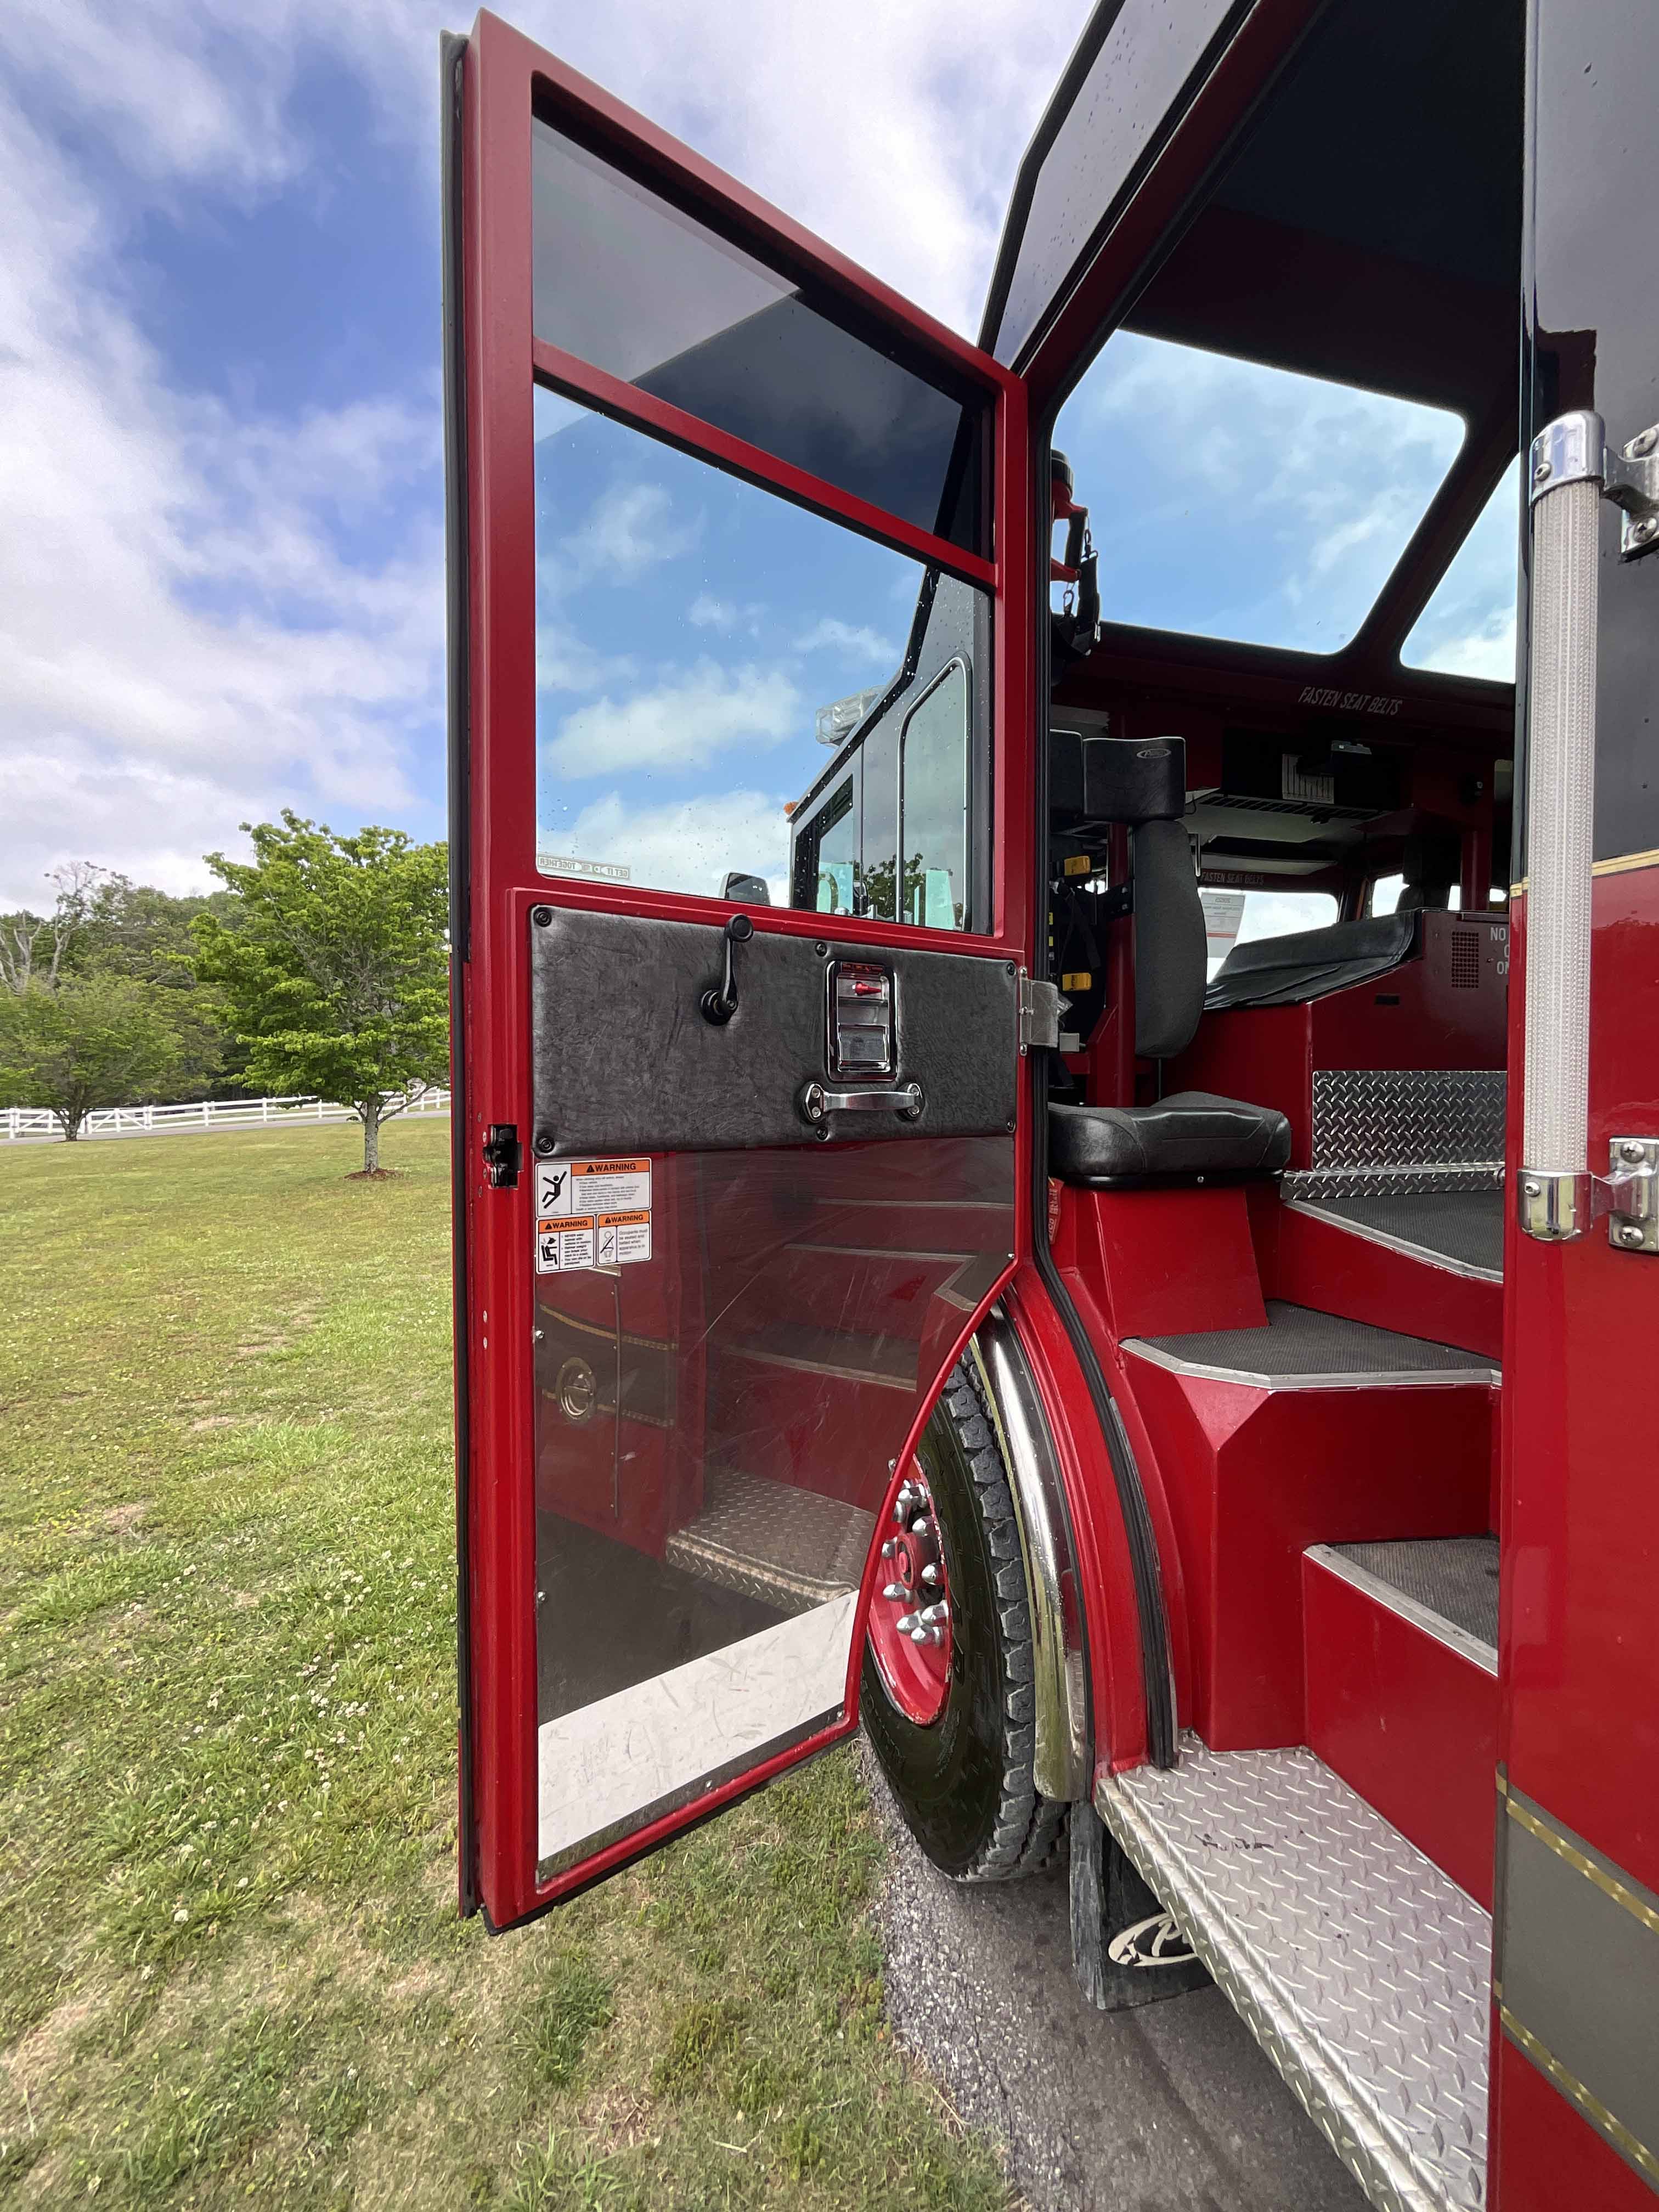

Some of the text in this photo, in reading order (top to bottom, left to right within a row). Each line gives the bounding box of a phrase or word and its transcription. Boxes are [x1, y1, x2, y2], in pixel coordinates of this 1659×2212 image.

[1298, 686, 1403, 715] FASTEN SEAT BELTS
[1200, 871, 1226, 882] FASTEN
[1490, 927, 1506, 941] NO
[595, 1163, 636, 1172] WARNING
[611, 1214, 644, 1223] WARNING
[552, 1220, 588, 1229] WARNING
